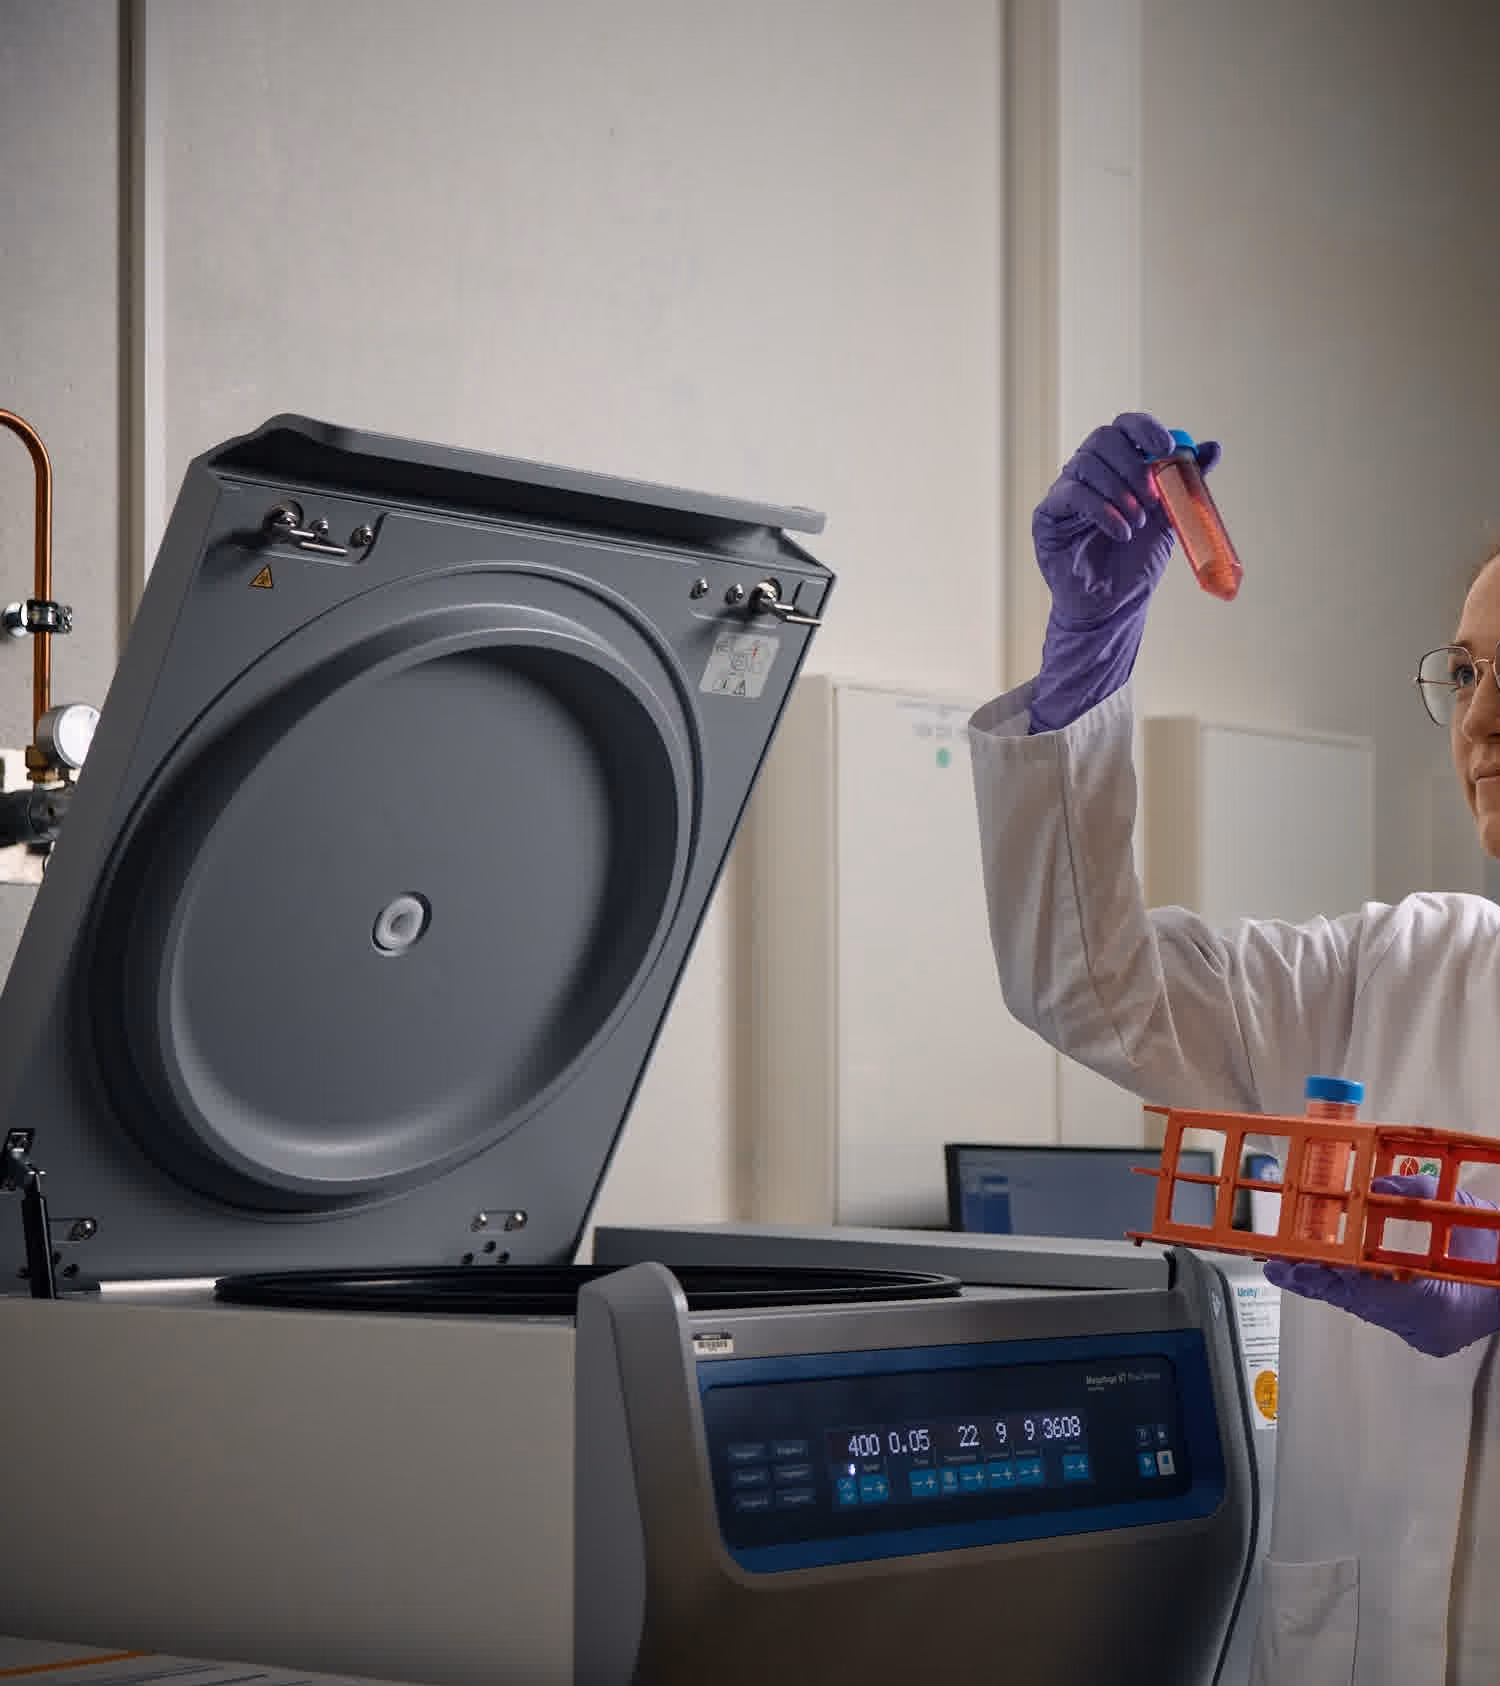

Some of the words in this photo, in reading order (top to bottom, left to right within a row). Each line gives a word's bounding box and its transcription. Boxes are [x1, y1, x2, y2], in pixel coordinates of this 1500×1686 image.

[849, 1434, 880, 1456] 400
[888, 1429, 930, 1453] 0.05
[958, 1424, 979, 1447] 22
[996, 1422, 1007, 1443] 9
[1024, 1420, 1035, 1440] 9
[1043, 1416, 1081, 1438] 3608
